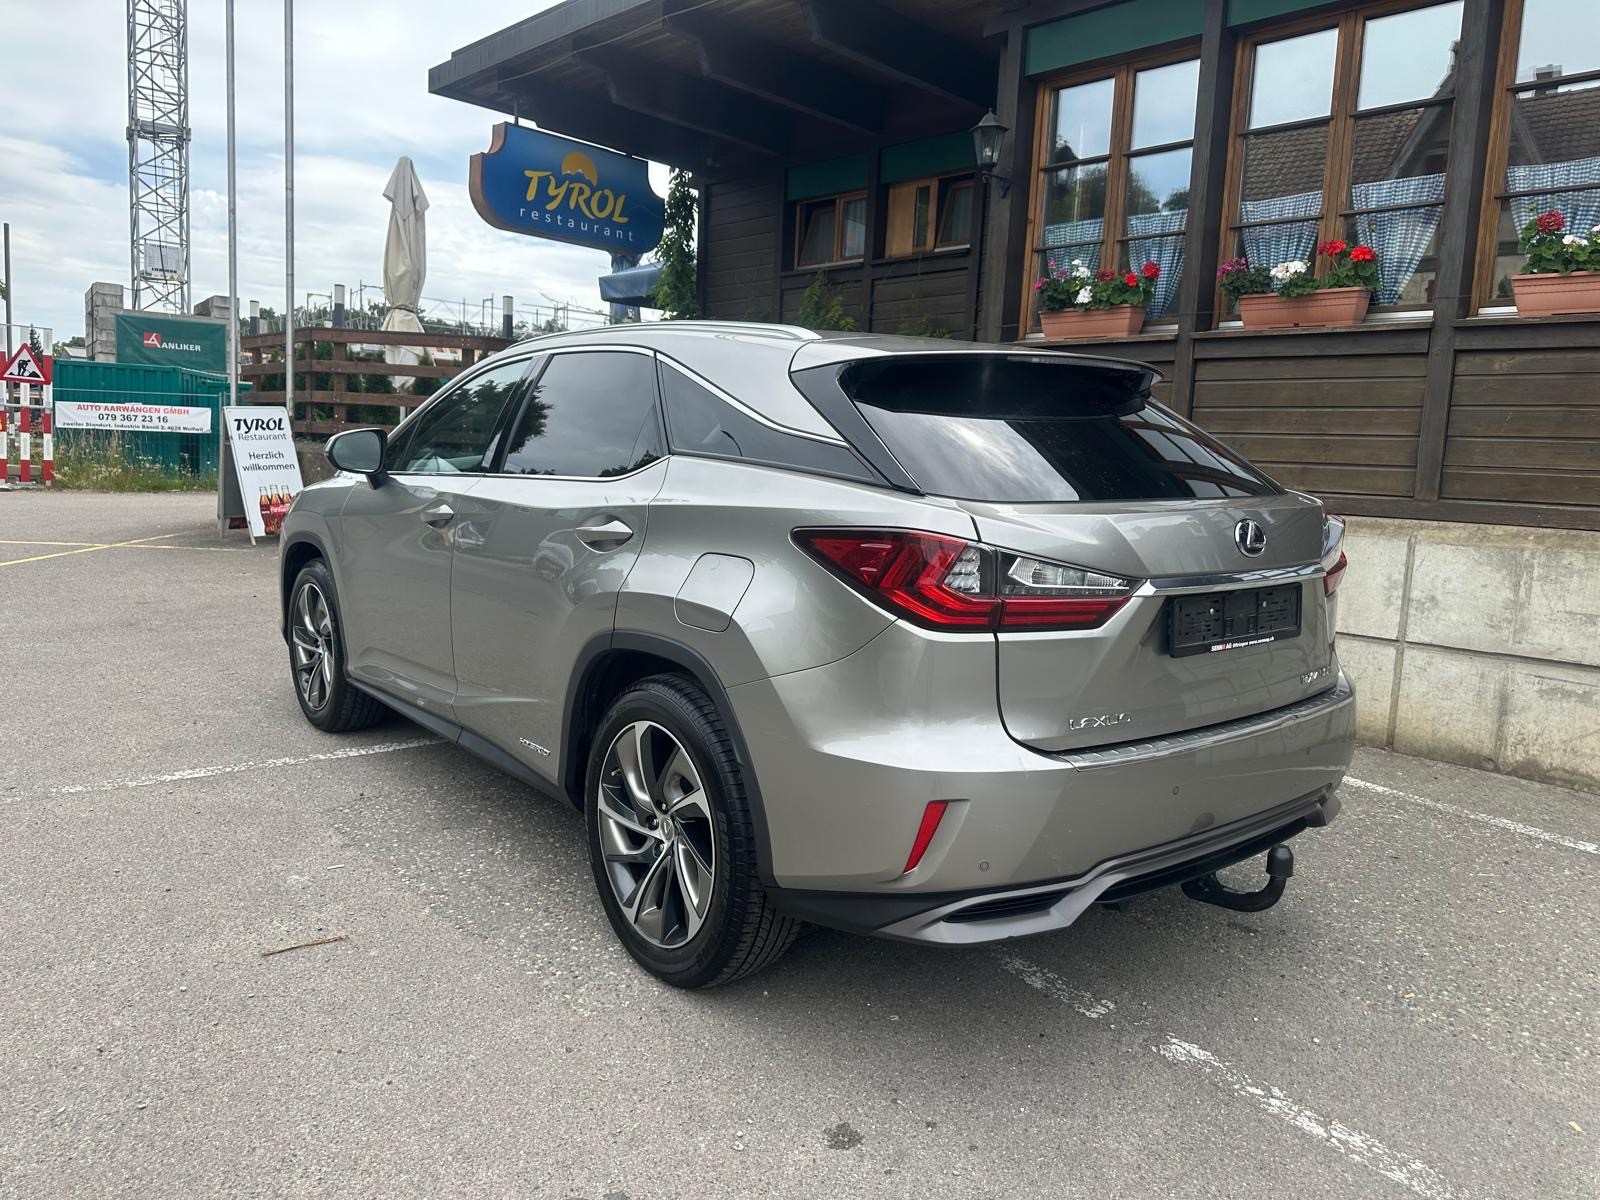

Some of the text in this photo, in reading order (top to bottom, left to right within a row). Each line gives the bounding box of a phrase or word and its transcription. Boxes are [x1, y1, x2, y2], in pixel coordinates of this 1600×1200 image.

[523, 169, 630, 224] TYROL
[519, 207, 634, 242] restaurant
[161, 341, 201, 352] ANLIKER
[76, 404, 102, 412] AUTO
[163, 407, 190, 415] GMBH
[97, 413, 169, 424] 079 367 23 16
[233, 417, 285, 434] TYROL
[237, 432, 287, 441] Restaurant
[248, 450, 285, 460] Herzlich
[242, 463, 296, 472] willkommen
